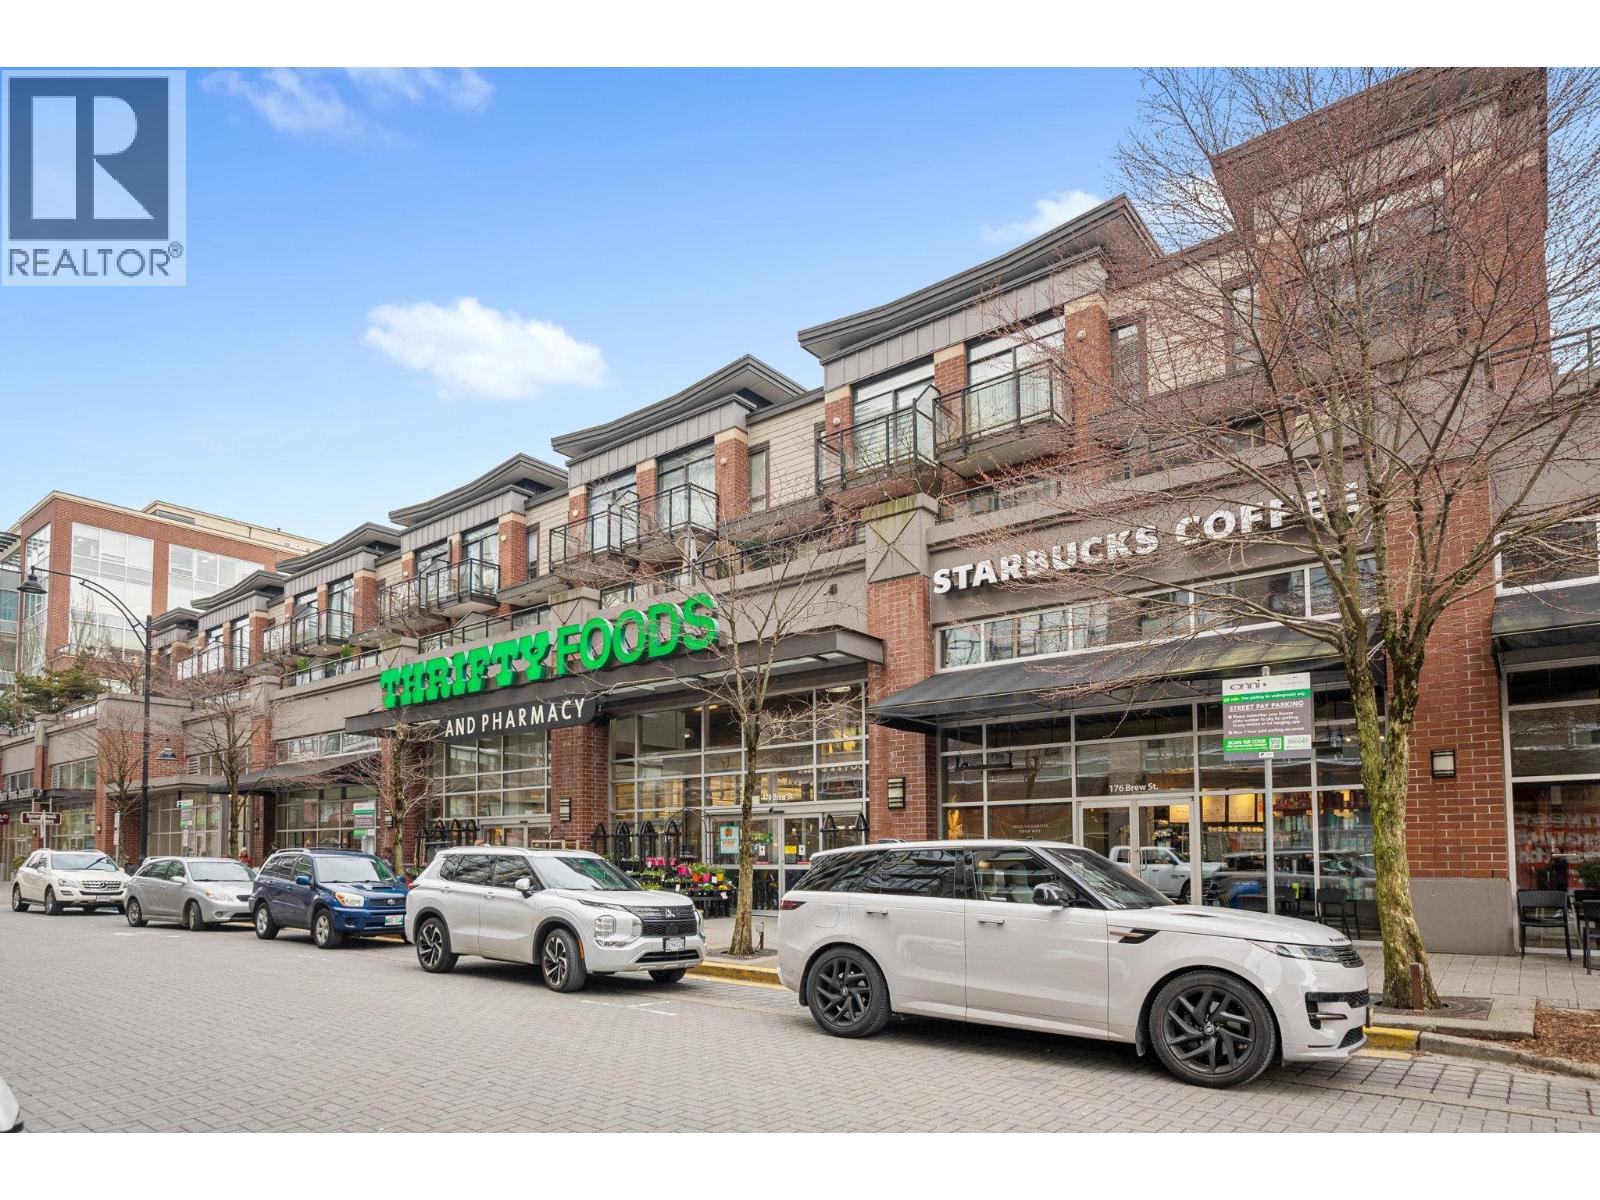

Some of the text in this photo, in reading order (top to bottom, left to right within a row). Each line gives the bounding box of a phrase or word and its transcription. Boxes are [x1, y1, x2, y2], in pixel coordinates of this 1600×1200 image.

[933, 525, 1159, 594] STARBUCKS
[379, 591, 721, 709] THRIFTY FOODS
[445, 697, 587, 738] AND PHARMACY
[1109, 784, 1124, 792] 176
[1125, 783, 1146, 792] Brew
